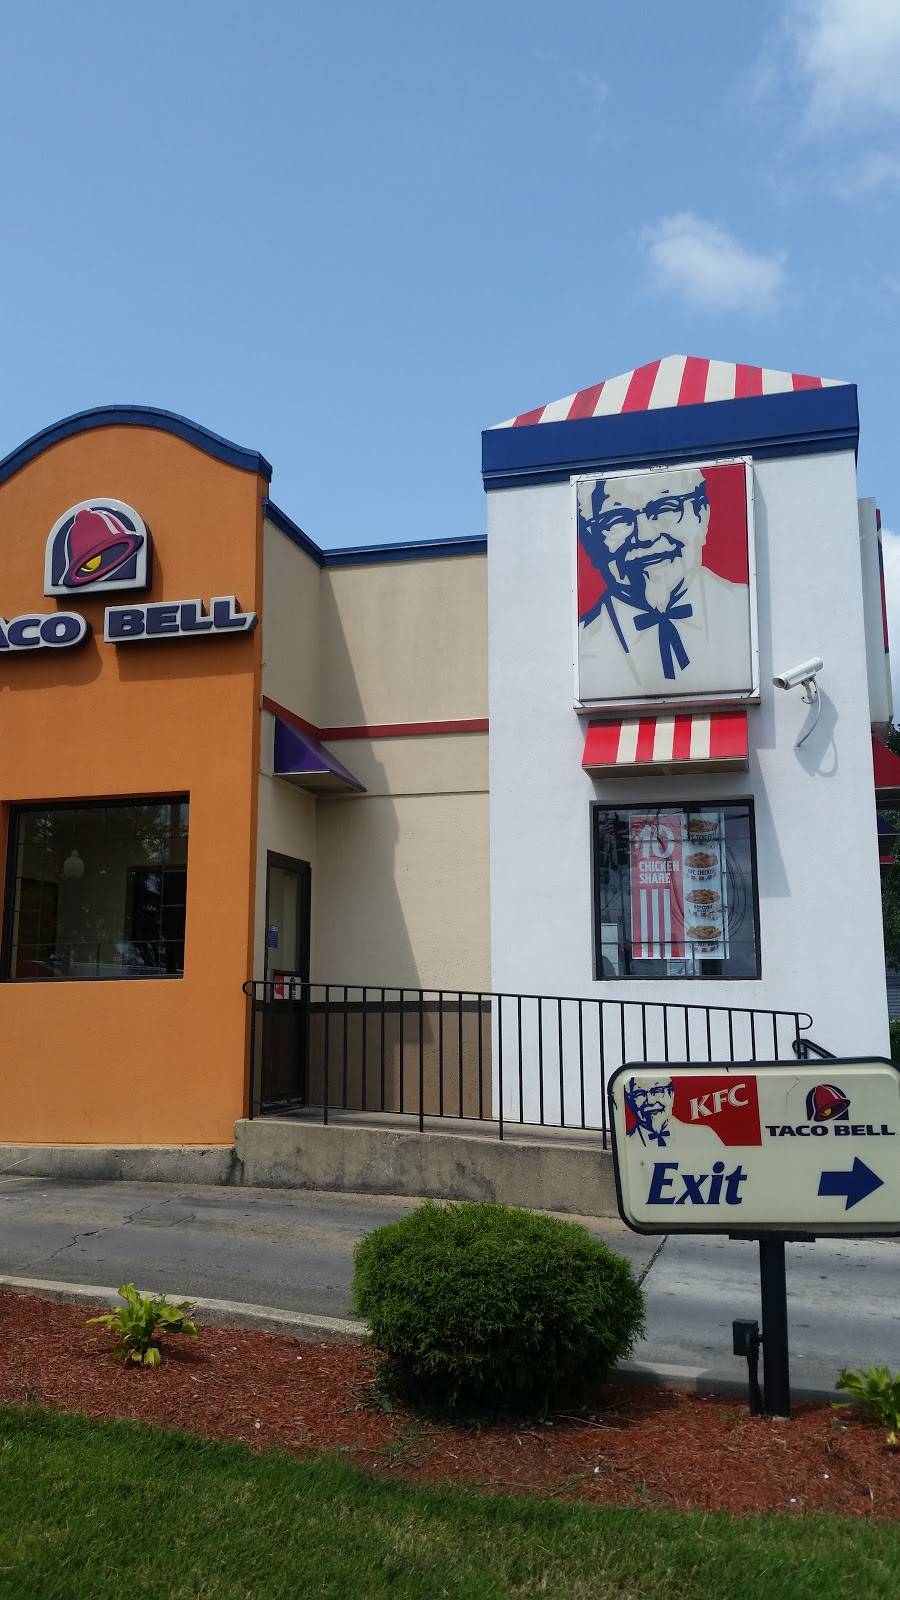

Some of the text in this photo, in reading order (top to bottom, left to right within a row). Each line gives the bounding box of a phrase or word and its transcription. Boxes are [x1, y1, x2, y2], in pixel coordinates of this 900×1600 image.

[107, 600, 248, 638] BELL
[639, 861, 680, 872] CHICKEN
[639, 872, 671, 884] SHARE
[689, 1083, 749, 1121] KFC
[765, 1124, 896, 1137] TACO BELL
[645, 1161, 748, 1205] Exit
